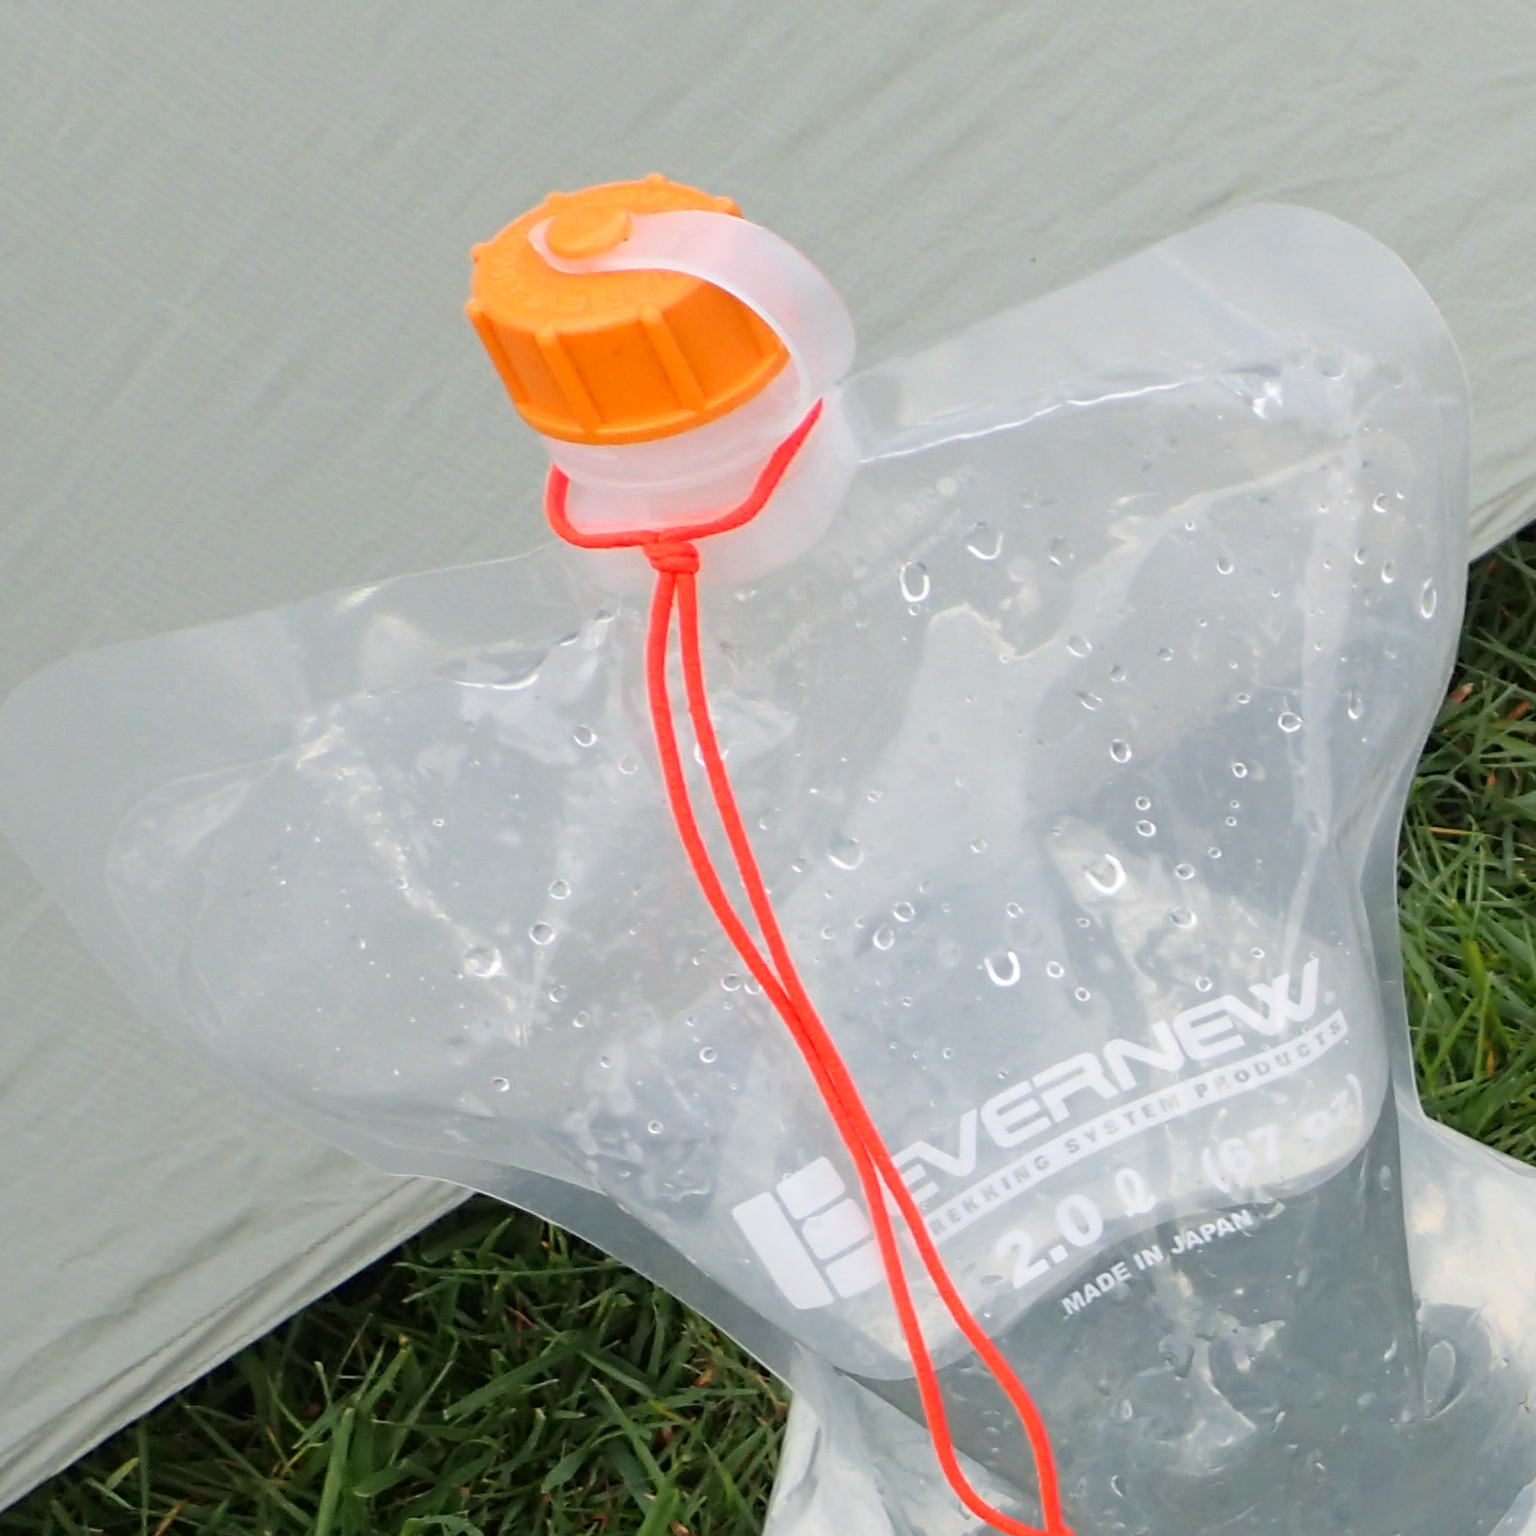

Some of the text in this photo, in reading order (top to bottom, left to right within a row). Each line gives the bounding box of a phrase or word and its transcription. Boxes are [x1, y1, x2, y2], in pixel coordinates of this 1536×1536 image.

[920, 1017, 1343, 1240] REKKING SYSTEM PRODUCTS
[995, 1194, 1104, 1290] 2.0
[1061, 1209, 1254, 1316] MADE IN JAPAN
